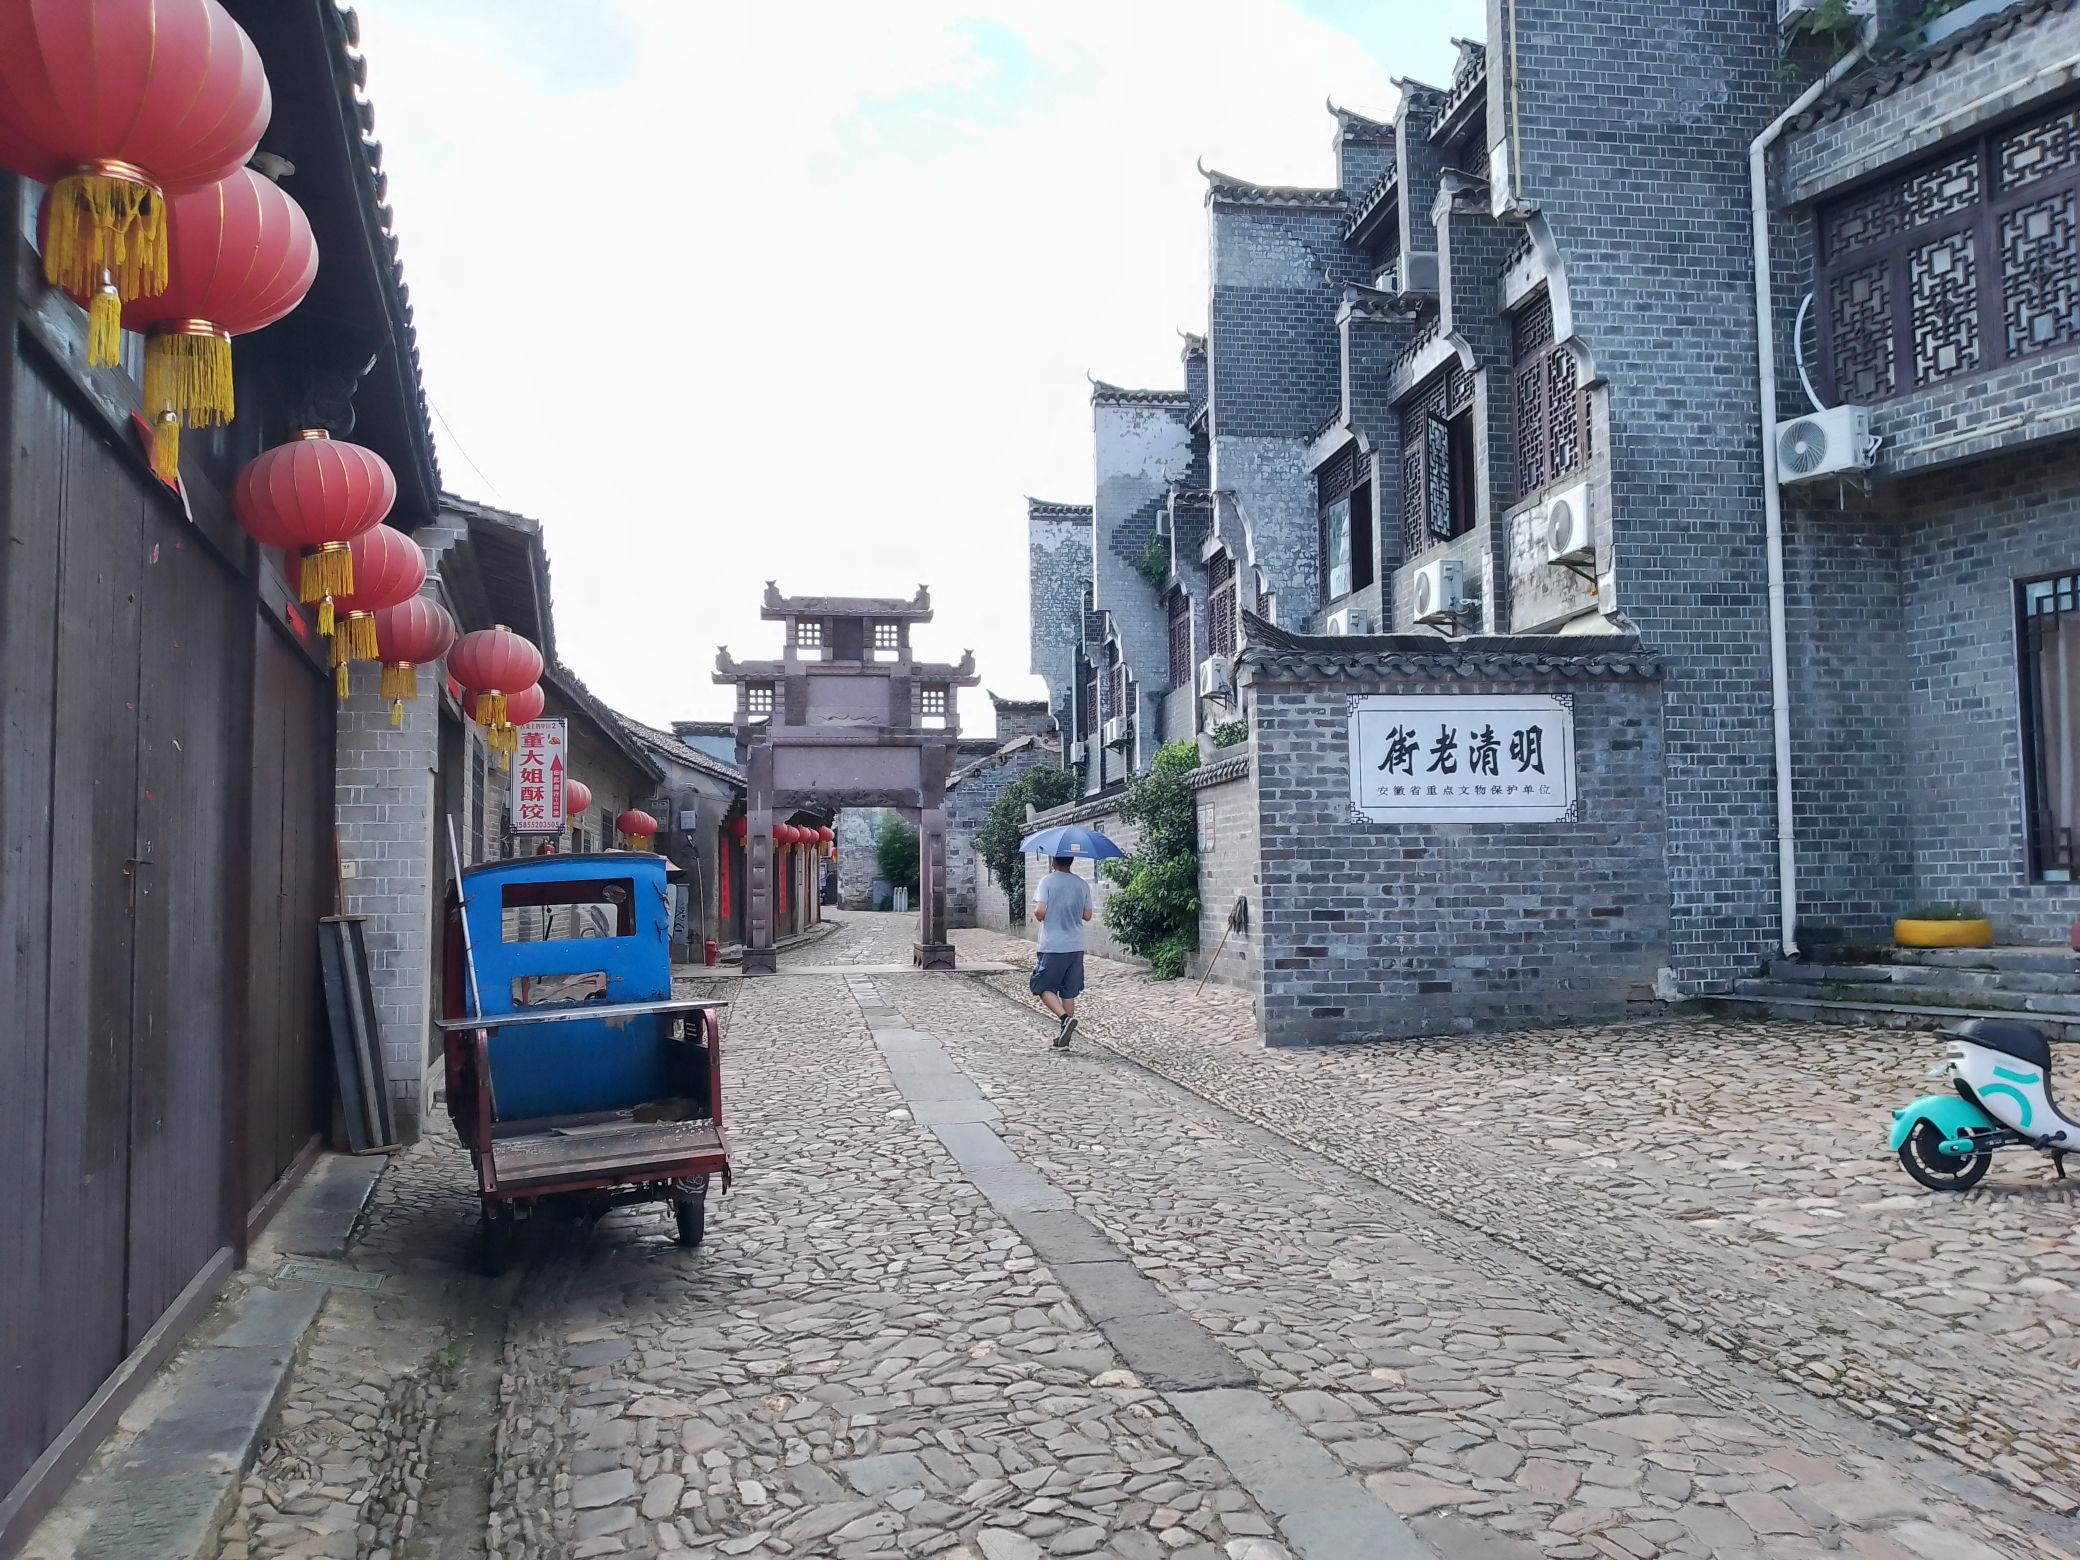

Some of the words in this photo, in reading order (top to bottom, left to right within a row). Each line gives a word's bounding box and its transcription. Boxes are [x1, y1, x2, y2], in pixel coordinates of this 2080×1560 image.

[519, 732, 545, 820] 董大姐酥饺
[1377, 785, 1551, 796] 安徽省重点文物保护单位
